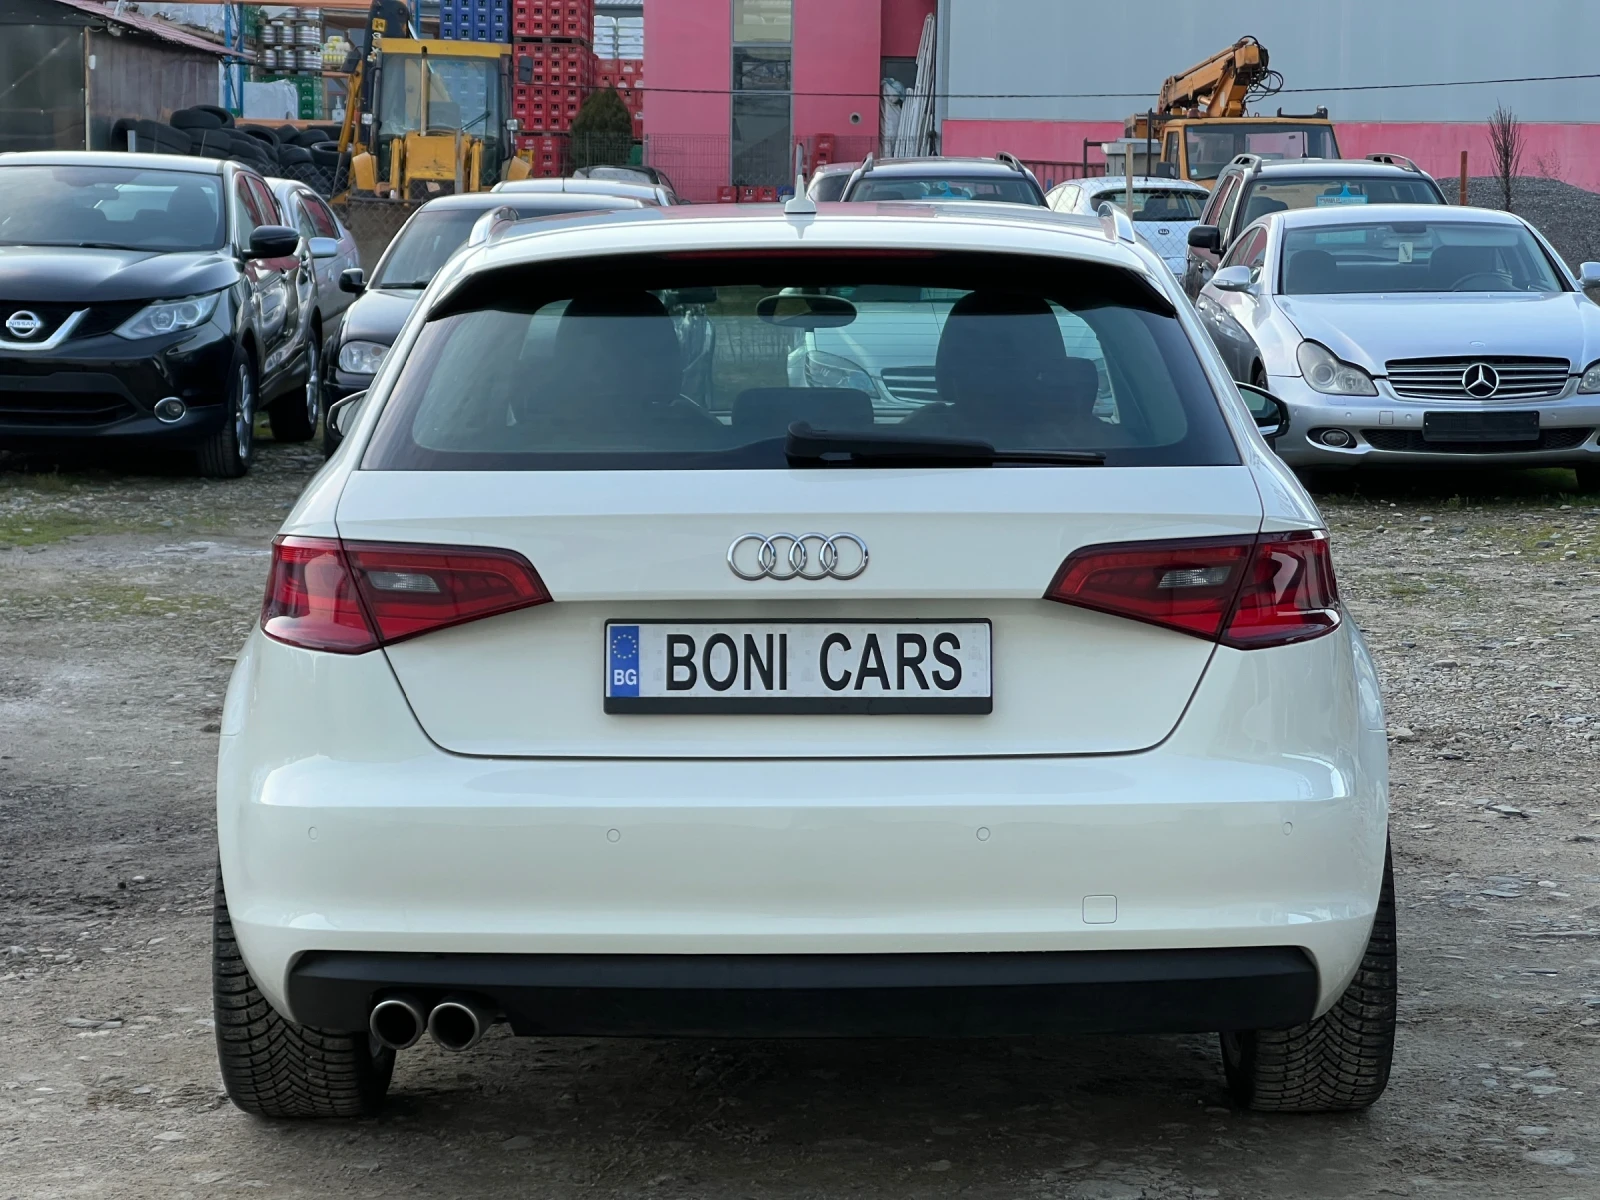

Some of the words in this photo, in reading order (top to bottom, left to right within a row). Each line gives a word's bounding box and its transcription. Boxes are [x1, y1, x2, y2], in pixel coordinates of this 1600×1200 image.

[613, 669, 638, 685] BG
[666, 633, 788, 691] BONI
[819, 632, 963, 691] CARS
